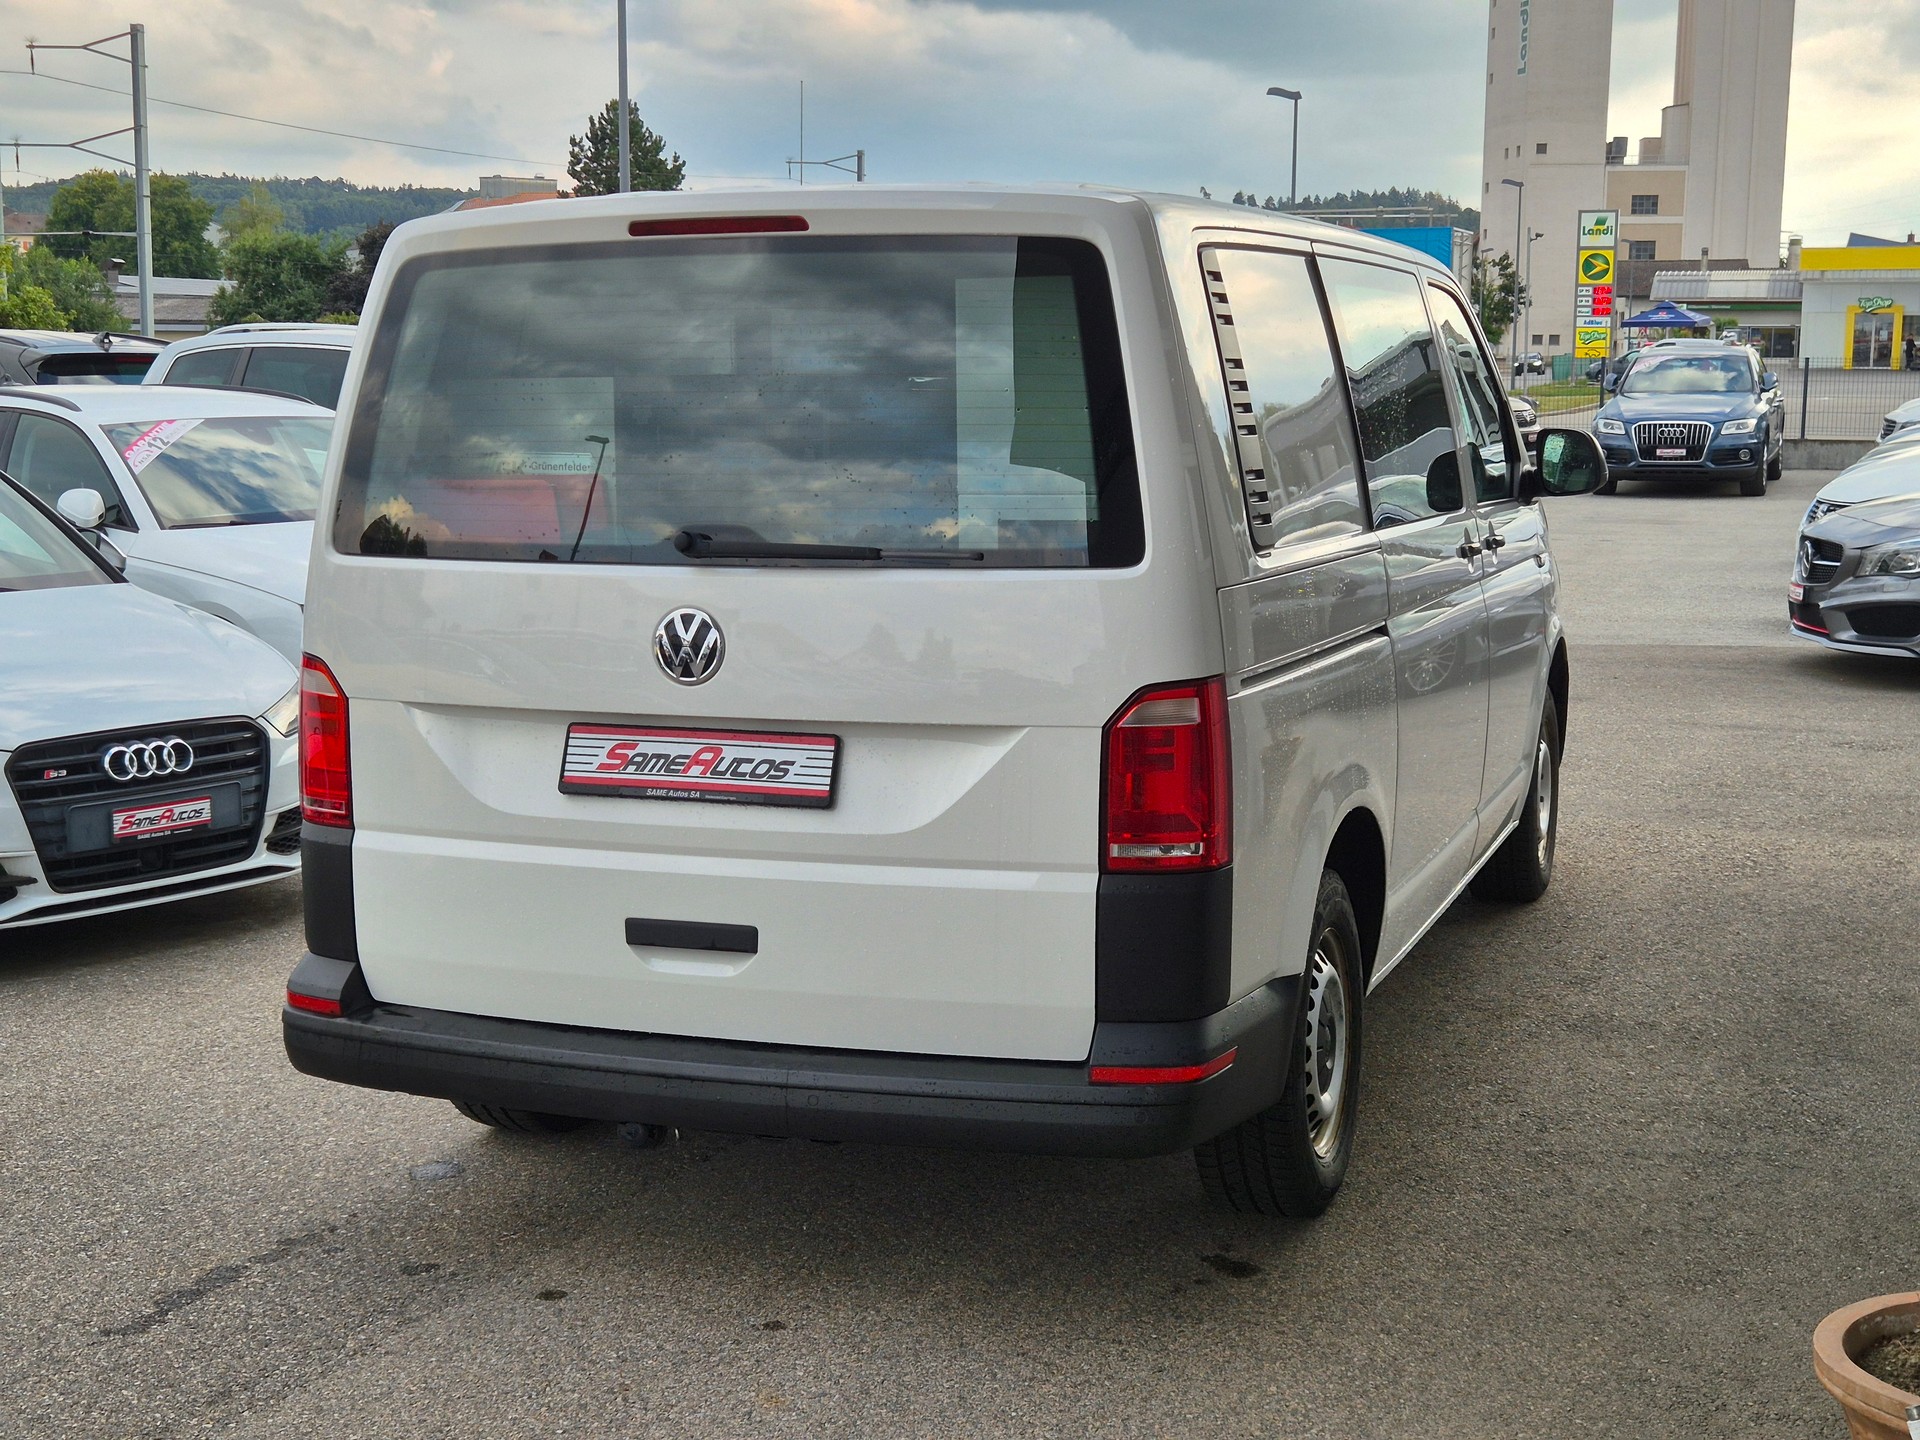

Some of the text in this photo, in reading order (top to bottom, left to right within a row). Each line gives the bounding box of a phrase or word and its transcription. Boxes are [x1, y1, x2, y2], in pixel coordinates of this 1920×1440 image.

[1517, 0, 1530, 75] Landi
[1582, 225, 1613, 236] Landi
[147, 436, 170, 450] 12
[646, 788, 668, 797] SAME
[668, 789, 688, 798] Autos
